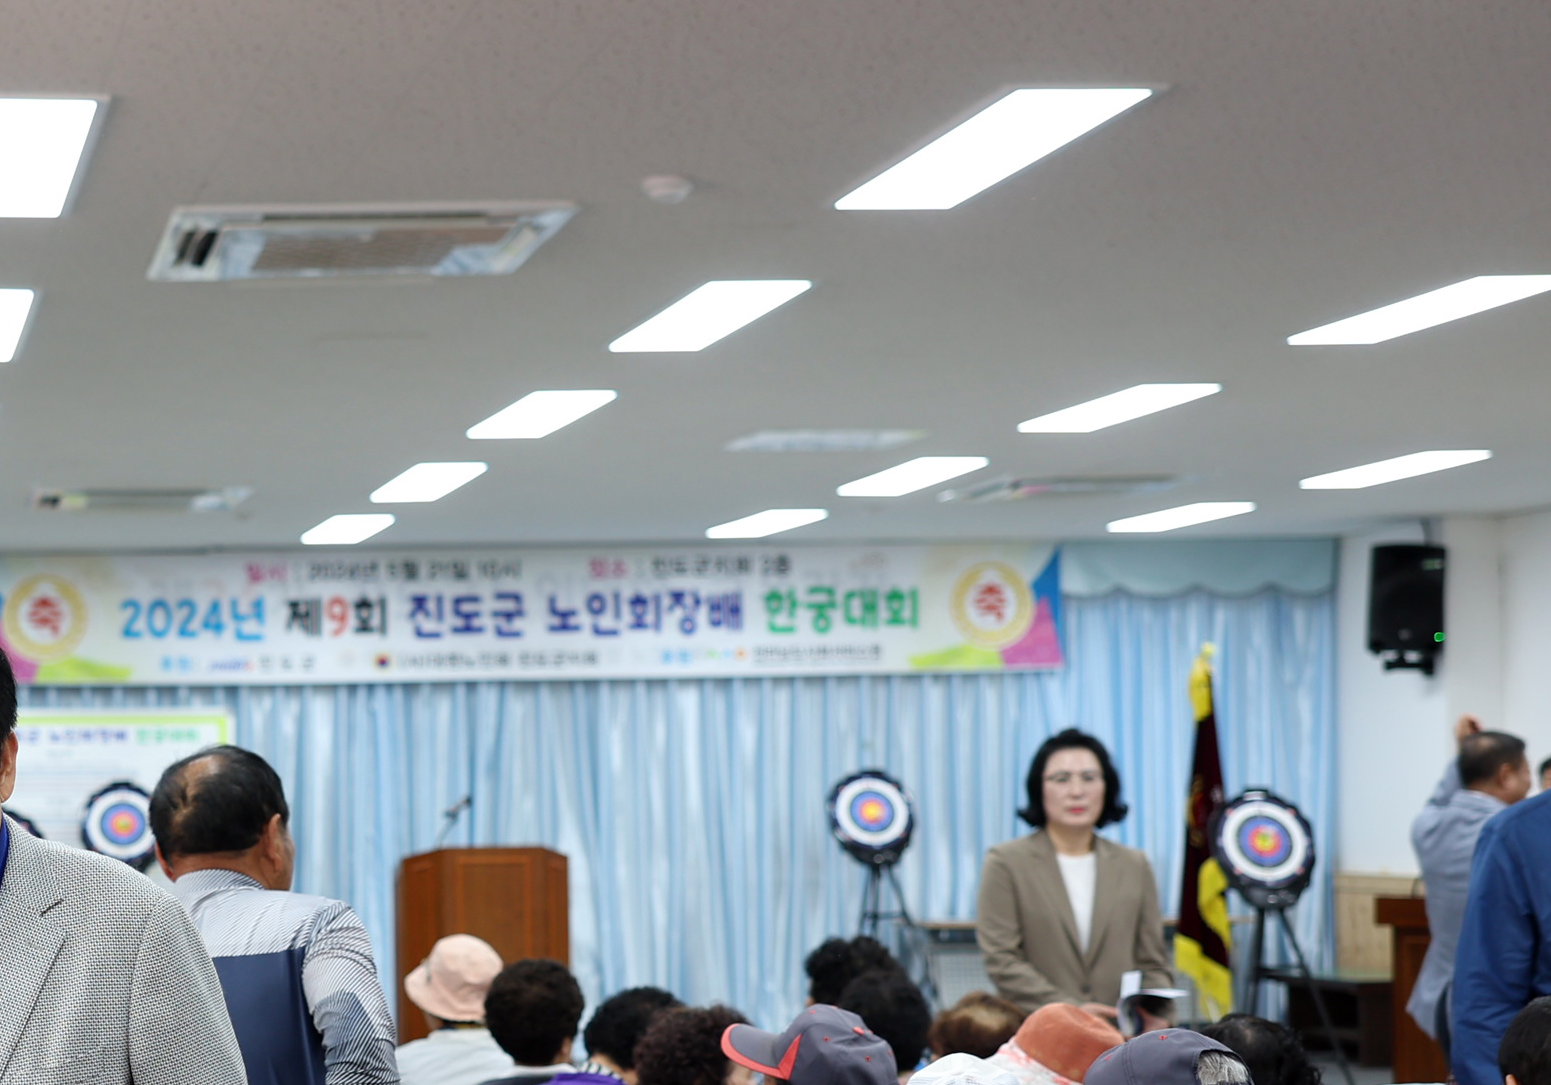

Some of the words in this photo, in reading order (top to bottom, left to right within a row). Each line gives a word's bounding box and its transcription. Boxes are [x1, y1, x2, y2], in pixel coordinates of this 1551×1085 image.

[27, 595, 64, 637] 축
[120, 597, 266, 641] 2024년
[285, 595, 389, 637] 제9회
[407, 592, 528, 639] 진도군
[547, 588, 745, 635] 노인회장배
[762, 585, 920, 634] 한궁대회
[973, 582, 1009, 623] 축
